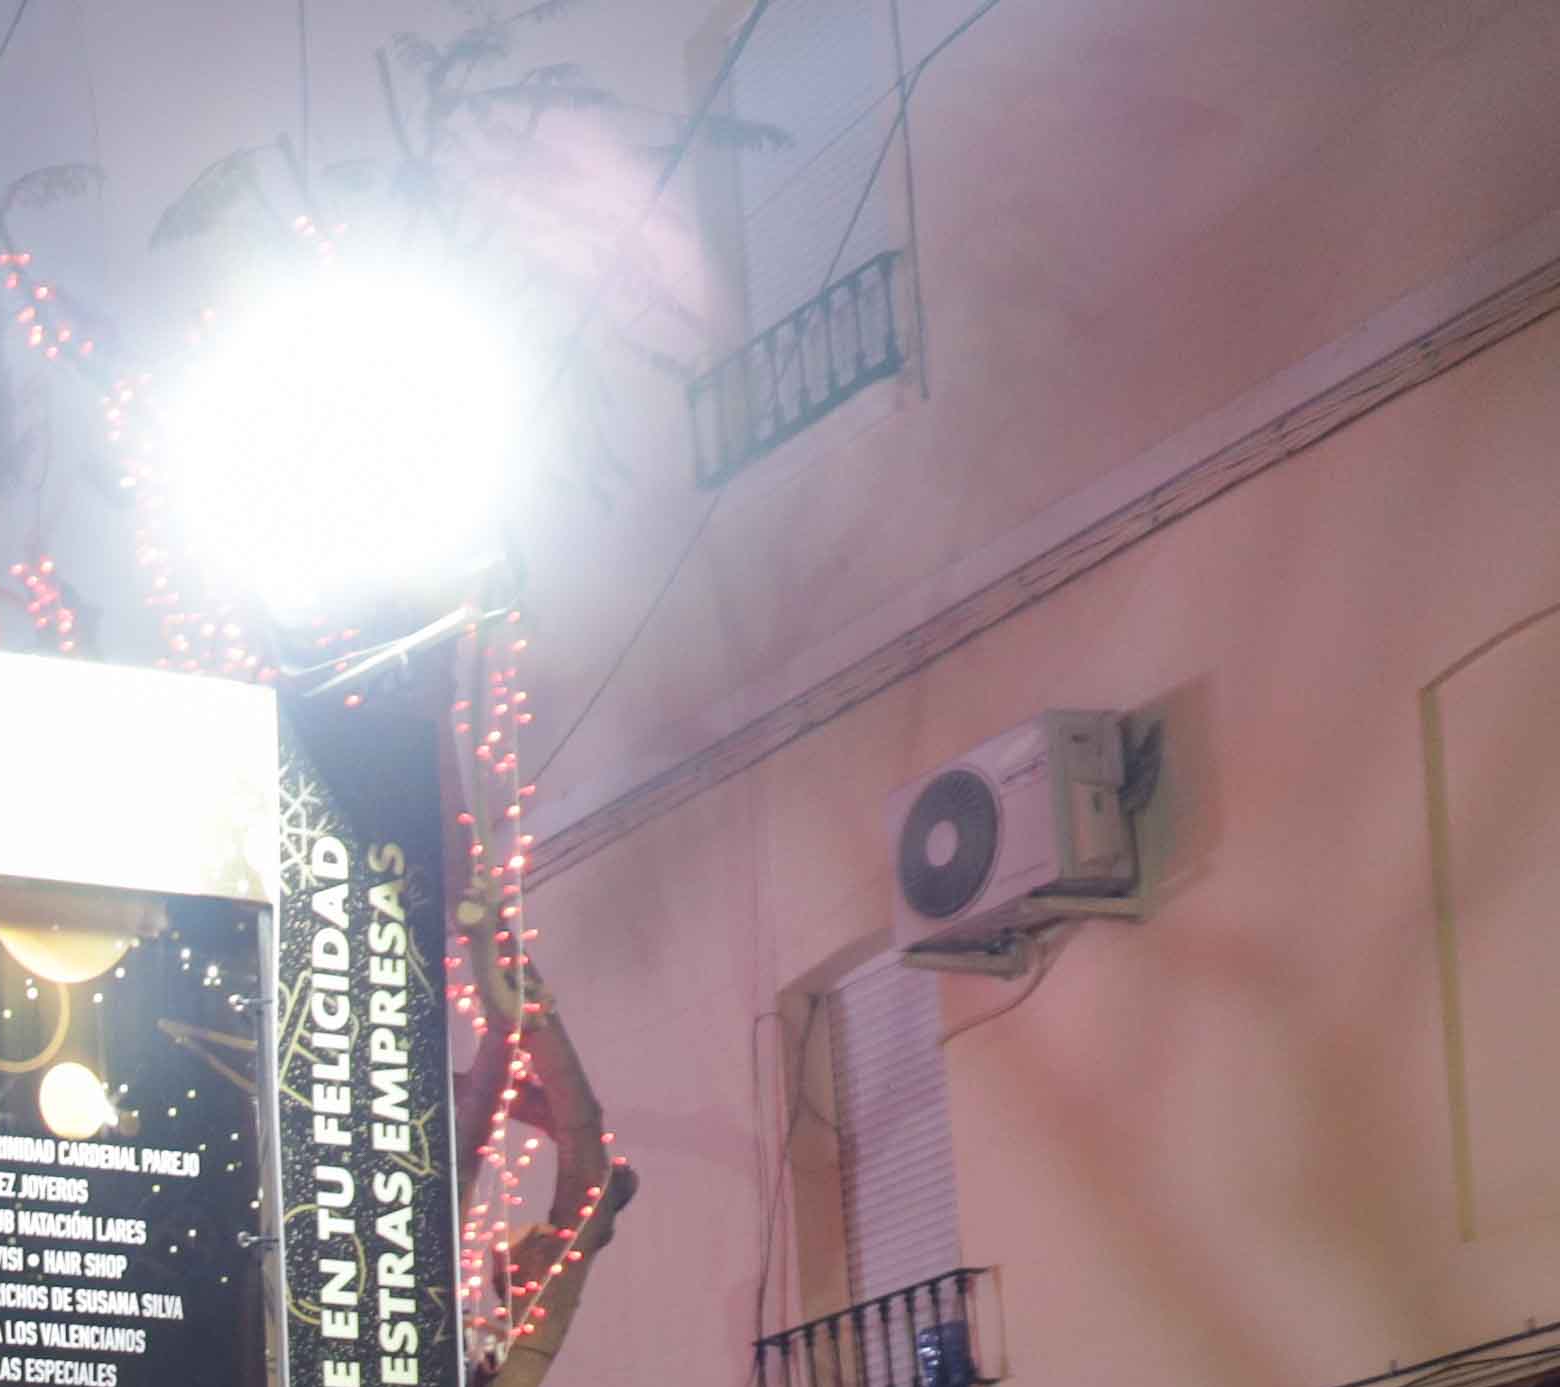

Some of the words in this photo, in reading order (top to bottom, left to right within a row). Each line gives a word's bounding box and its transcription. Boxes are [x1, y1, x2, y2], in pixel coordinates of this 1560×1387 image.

[313, 833, 353, 1156] FELICIDAD
[367, 840, 413, 1150] EMPRESAS
[316, 1160, 357, 1241] TU
[43, 1249, 82, 1276] HAIR
[84, 1253, 127, 1279] SHOP
[320, 1251, 359, 1340] EN
